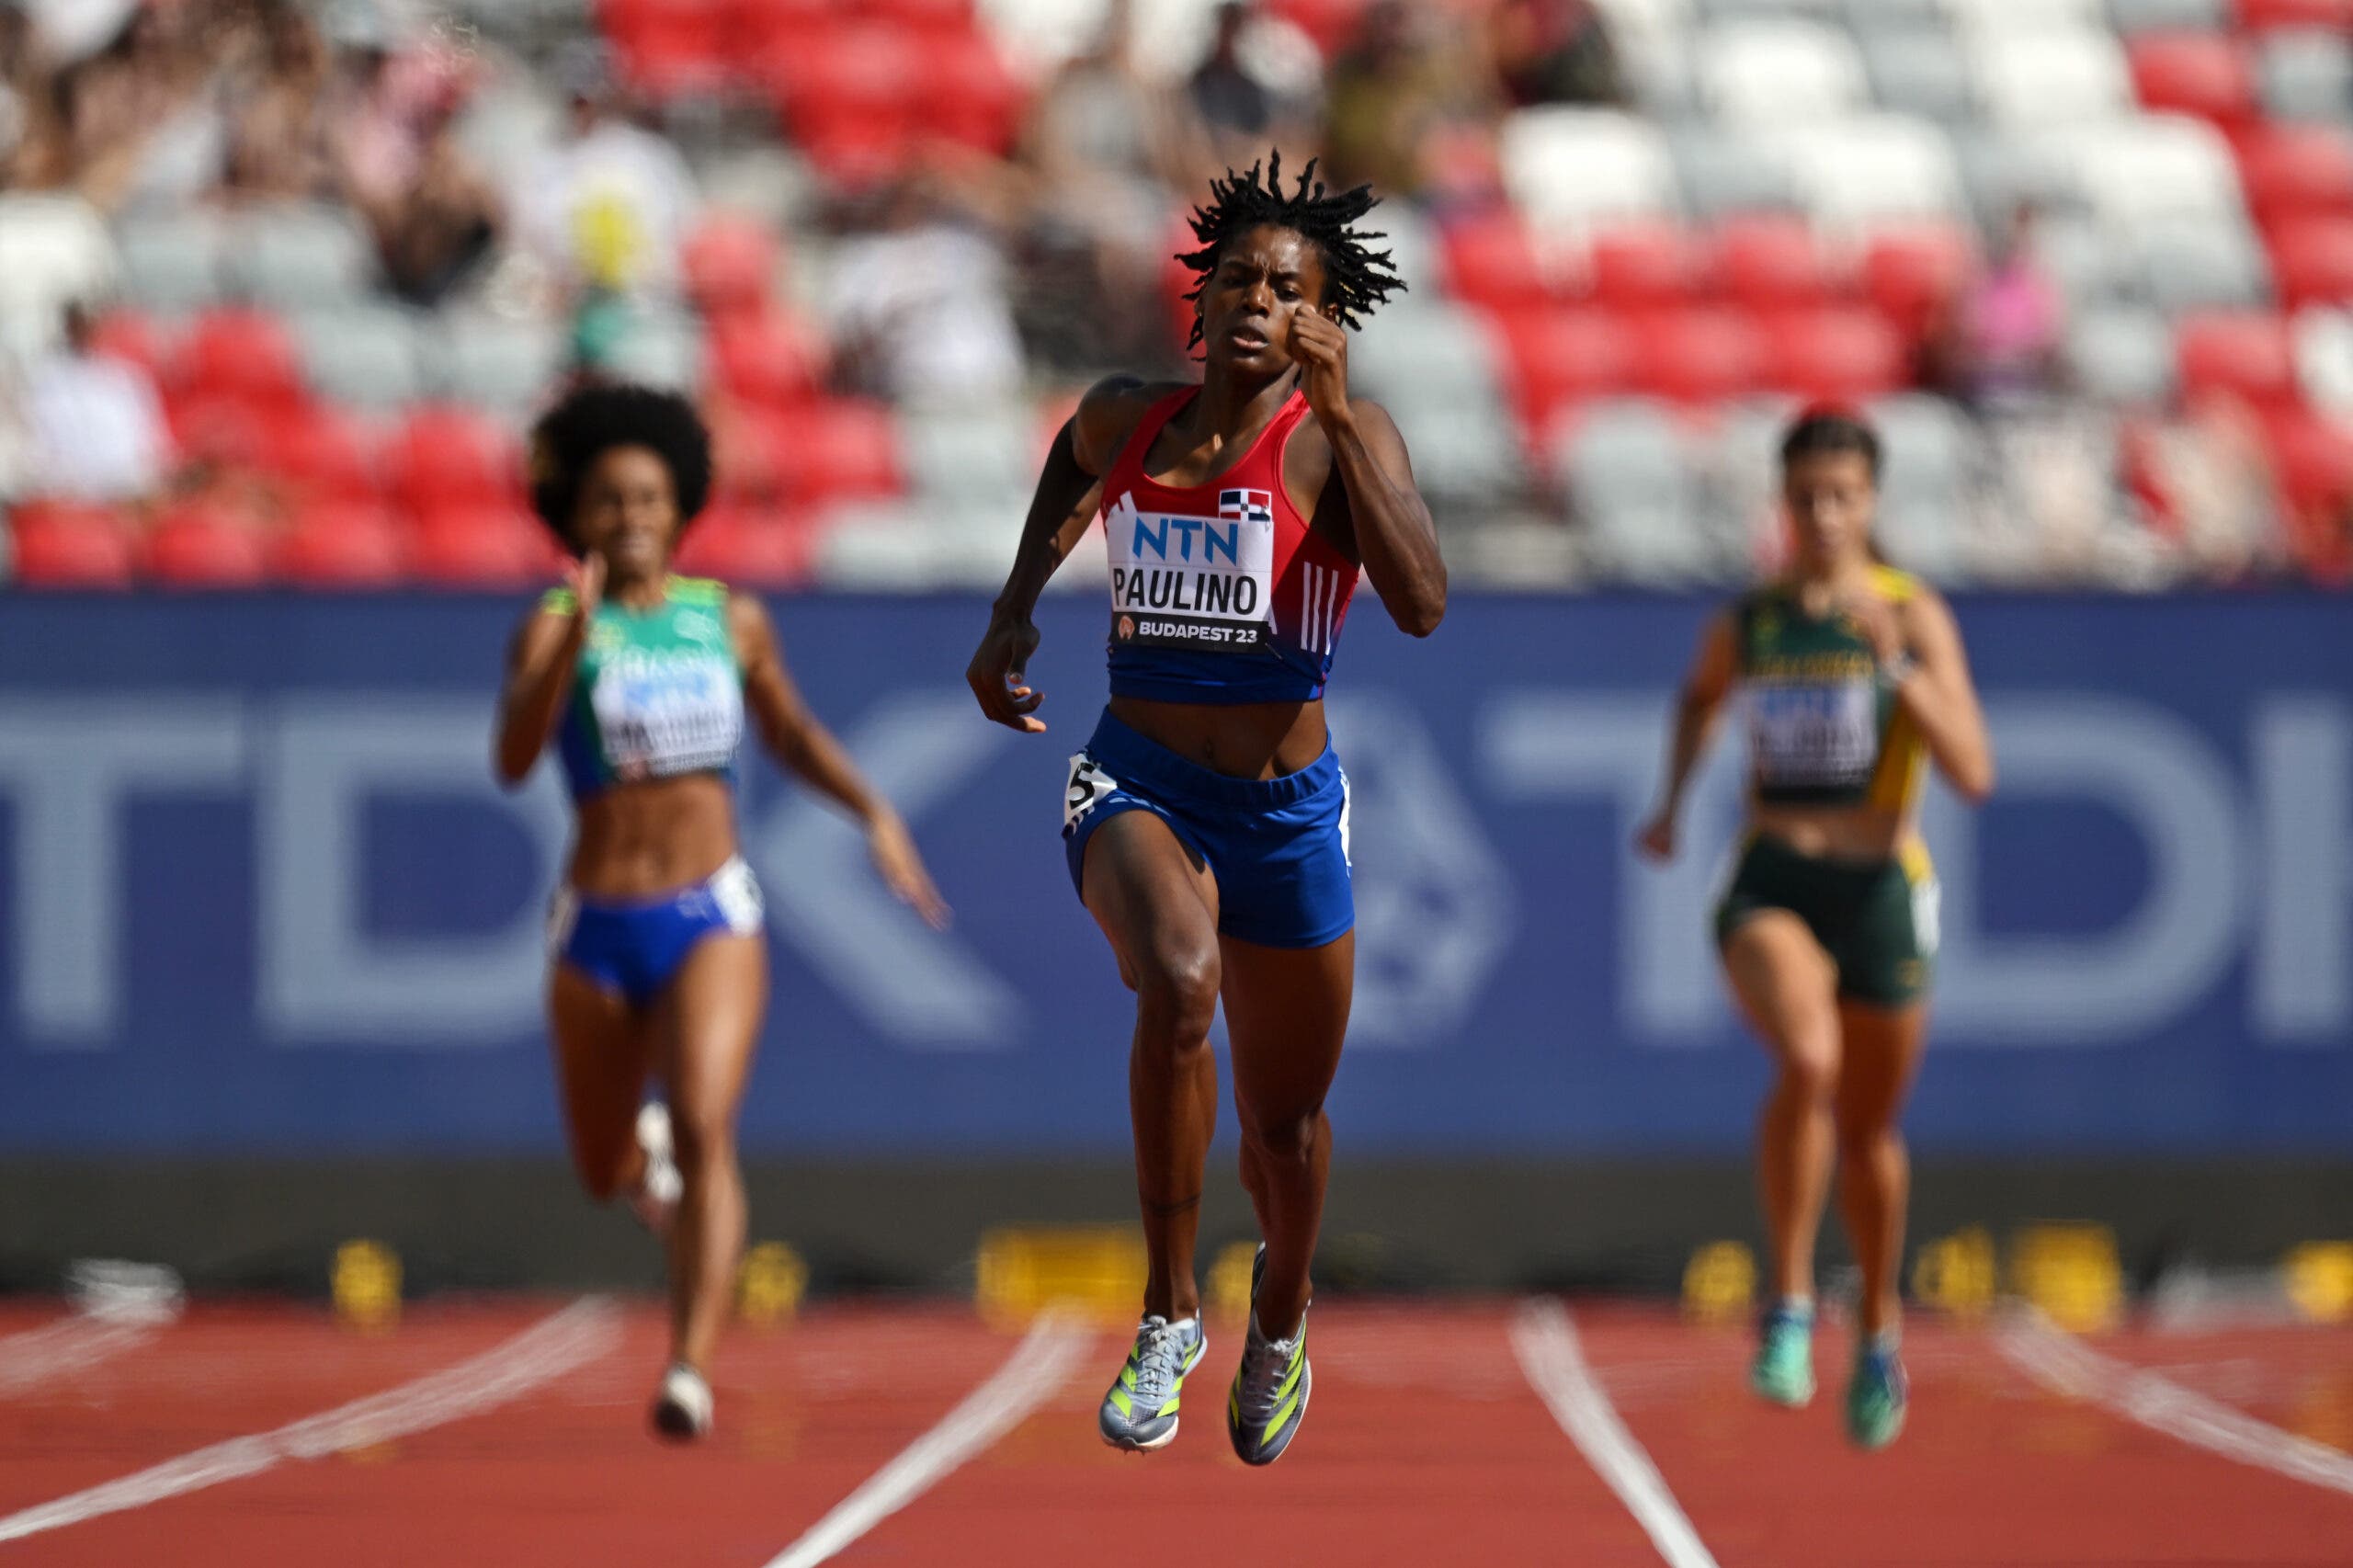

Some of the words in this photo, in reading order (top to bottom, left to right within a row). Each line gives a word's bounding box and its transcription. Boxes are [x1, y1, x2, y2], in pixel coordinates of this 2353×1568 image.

[1131, 516, 1239, 567] NTN
[1112, 567, 1258, 616] PAULINO
[1138, 620, 1234, 644] BUDAPEST
[1234, 629, 1259, 644] 23
[1068, 761, 1097, 811] 5
